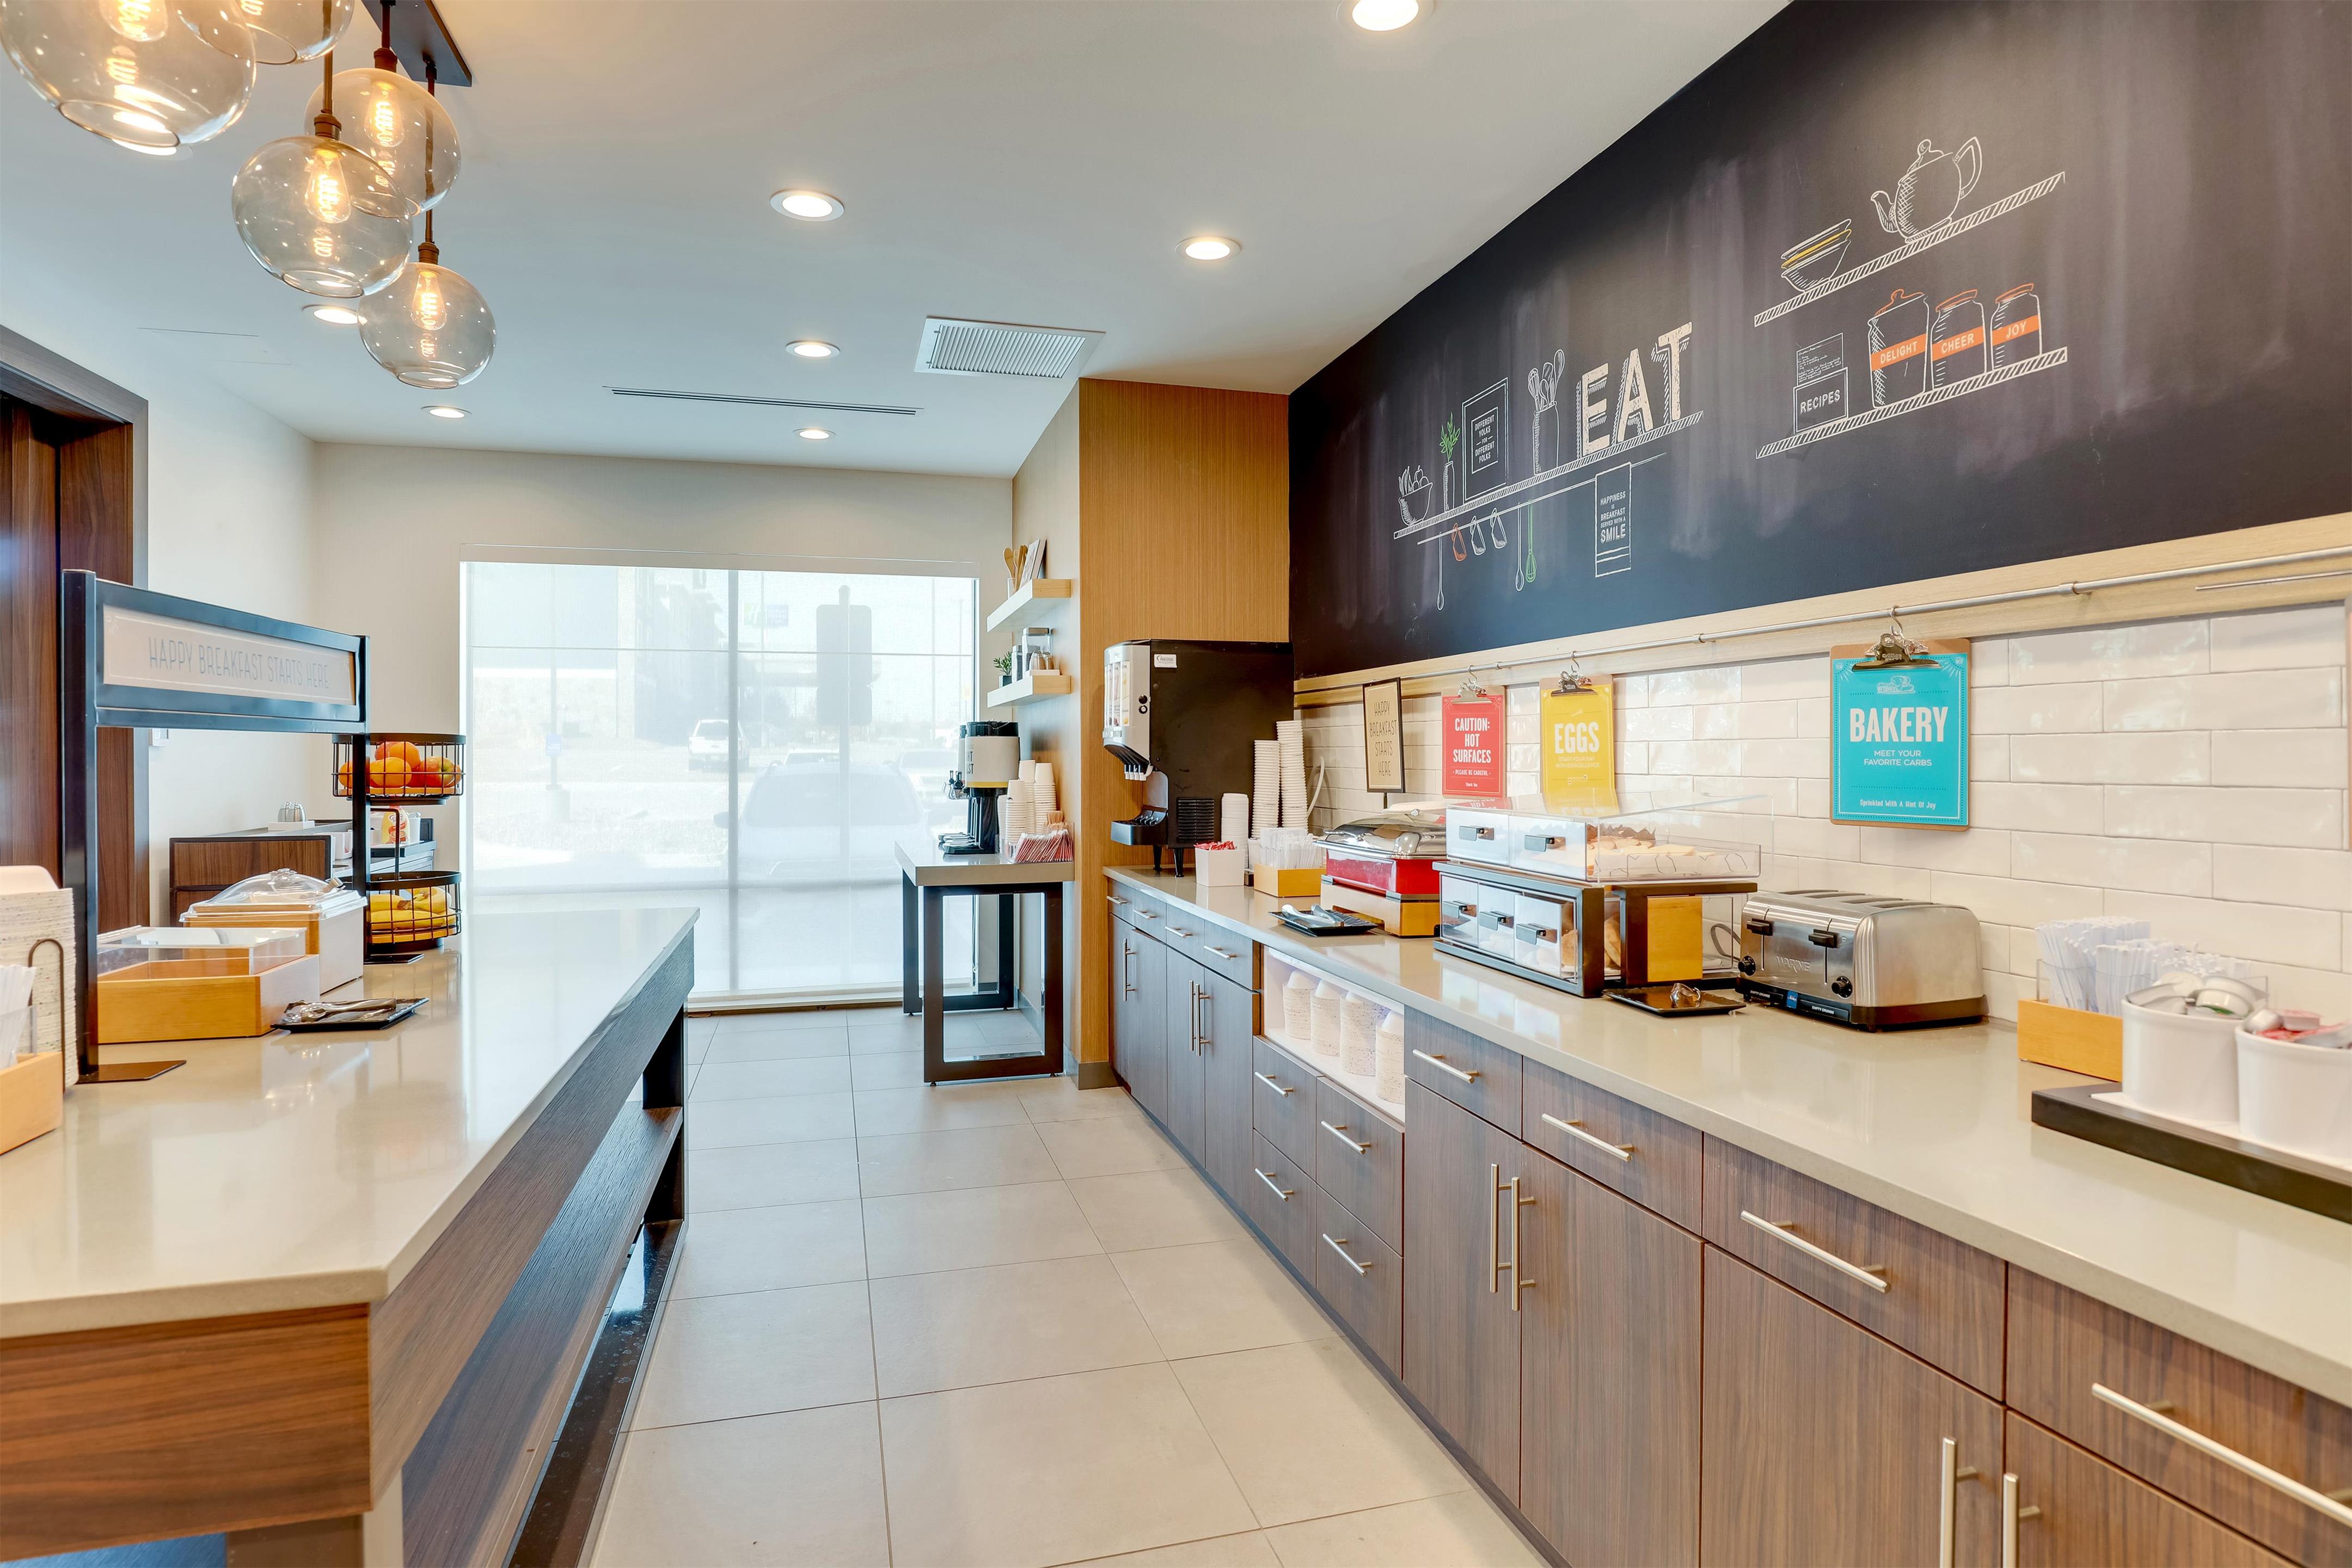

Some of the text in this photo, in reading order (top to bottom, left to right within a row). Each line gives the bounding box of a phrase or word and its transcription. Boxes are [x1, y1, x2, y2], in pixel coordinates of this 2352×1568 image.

[2006, 322, 2027, 338] JOY
[1941, 332, 1975, 354] CHEER
[1880, 340, 1918, 364] DELIGHT
[1581, 322, 1692, 457] EAT
[1800, 389, 1840, 414] RECIPES
[1475, 415, 1494, 431] DIFFERENT
[1479, 426, 1491, 437] YOLKS
[1475, 441, 1494, 457] DIFFERENT
[1479, 452, 1491, 463] FOLKS
[1600, 491, 1626, 505] HAPPINESS
[1601, 507, 1626, 521] BREAKFAST
[1600, 520, 1613, 528] SERVED
[1600, 523, 1626, 544] SMILE
[149, 637, 330, 689] HAPPY BREAKFAST STARTS HERE
[1374, 701, 1390, 717] HAPPY
[1369, 720, 1397, 737] BREAKFAST
[1455, 718, 1490, 731] CAUTION:
[1849, 706, 1949, 743] BAKERY
[1465, 733, 1480, 748] HOT
[1554, 722, 1600, 754] EGGS
[1375, 741, 1393, 756] STARTS
[1453, 750, 1491, 763] SURFACES
[1378, 761, 1391, 776] HERE
[1860, 799, 1883, 807] Sprinkled
[1926, 801, 1936, 810] Joy
